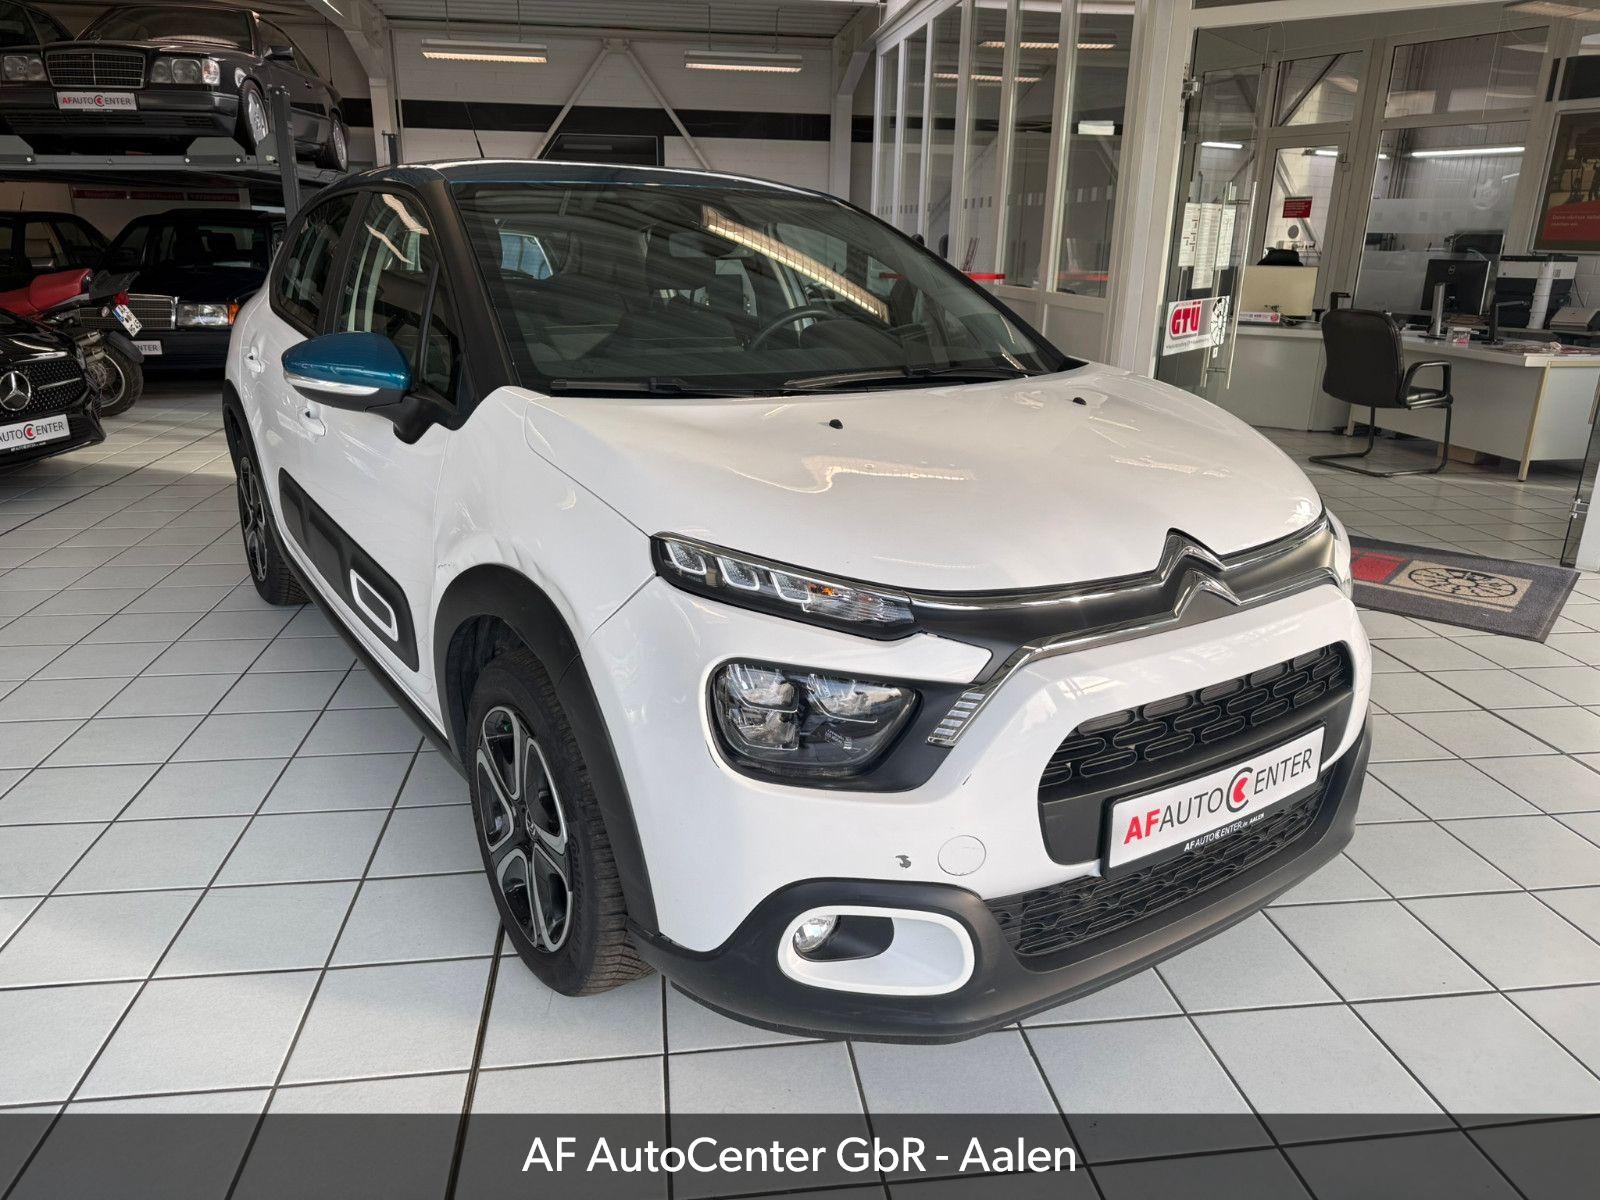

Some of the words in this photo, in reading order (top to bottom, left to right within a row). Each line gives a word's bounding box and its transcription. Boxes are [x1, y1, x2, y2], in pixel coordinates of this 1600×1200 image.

[63, 95, 131, 107] AFAUTOCENTER
[1171, 301, 1201, 335] GTÜ
[1123, 748, 1312, 845] AFAUTOCENTER
